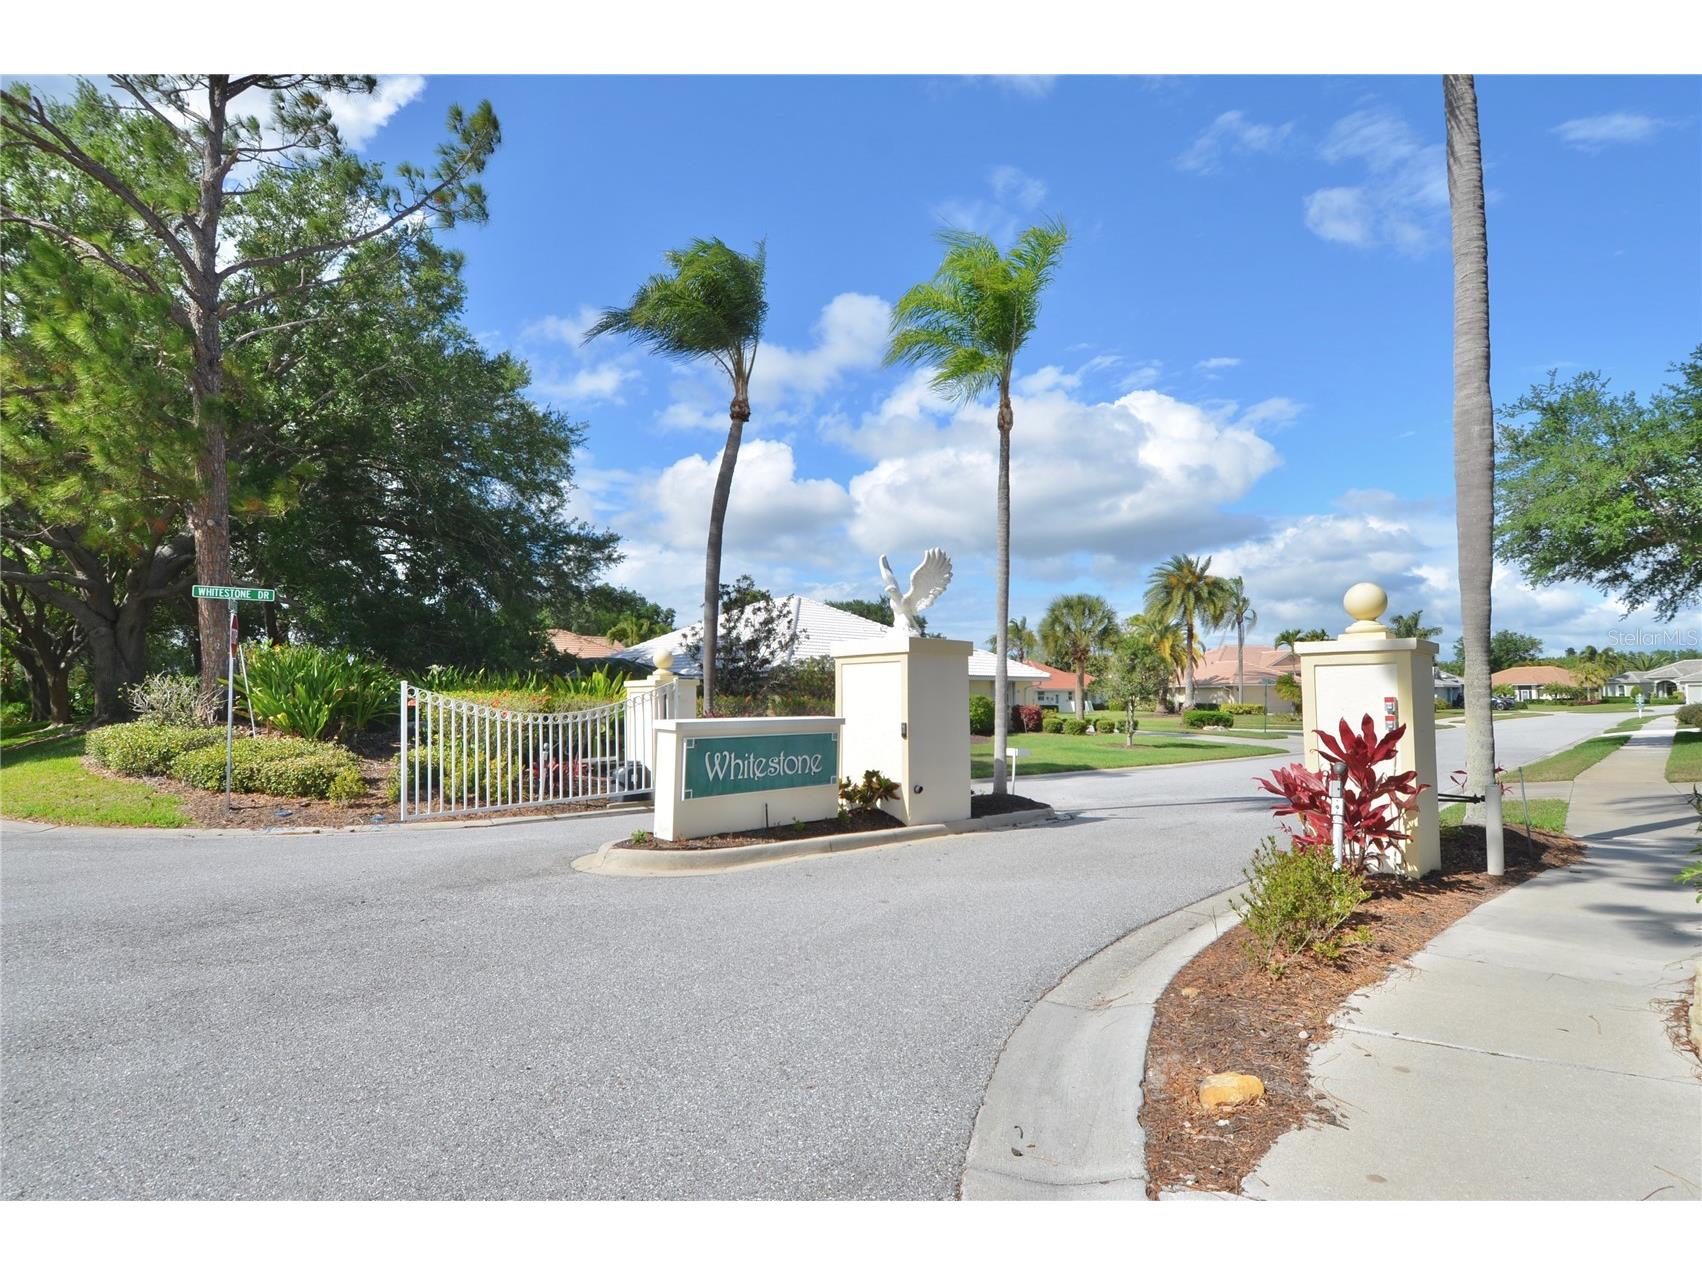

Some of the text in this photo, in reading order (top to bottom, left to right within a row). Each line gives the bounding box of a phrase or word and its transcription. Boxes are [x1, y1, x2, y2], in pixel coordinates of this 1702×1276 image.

[198, 588, 270, 599] WHITESTONE DR
[705, 751, 822, 782] Whitestone
